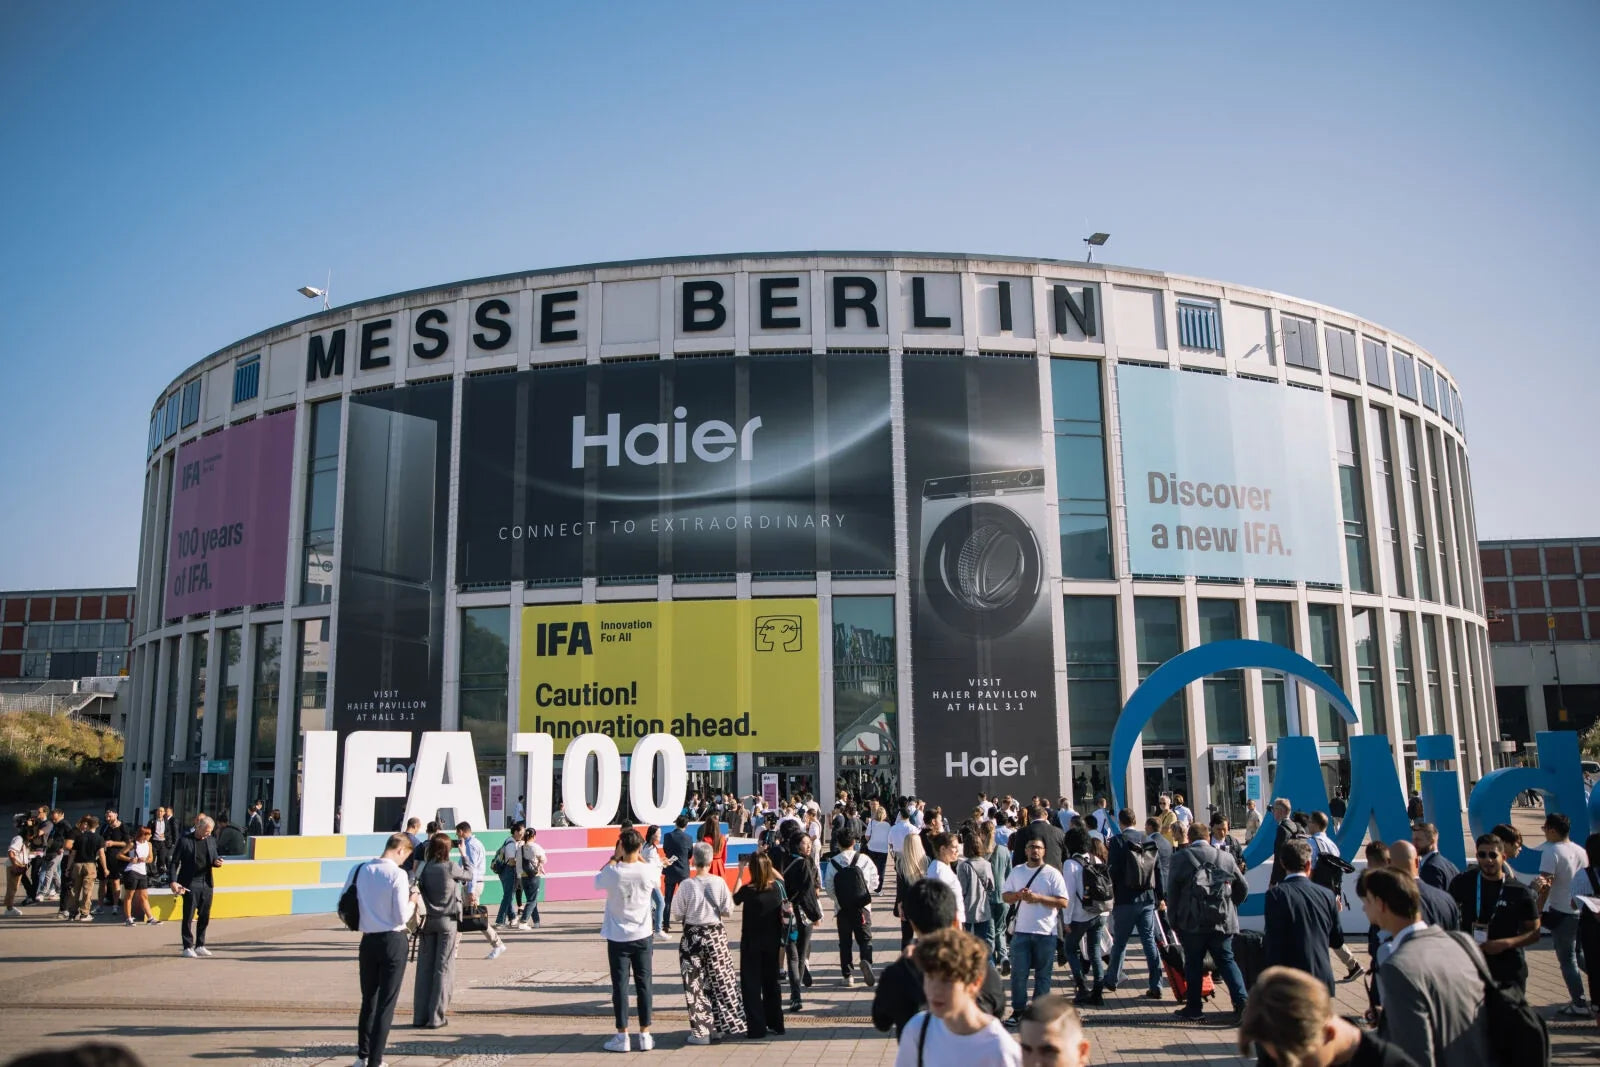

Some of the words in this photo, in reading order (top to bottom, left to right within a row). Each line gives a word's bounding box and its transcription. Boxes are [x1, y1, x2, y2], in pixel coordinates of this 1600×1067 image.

[307, 291, 578, 382] MESSE
[683, 276, 1097, 337] BERLIN
[572, 406, 762, 469] Haier
[182, 460, 200, 491] IFA
[1147, 471, 1272, 512] Discover
[178, 527, 199, 559] 100
[201, 522, 243, 559] years
[498, 521, 597, 541] CONNECT
[611, 518, 636, 535] TO
[650, 512, 847, 533] EXTRAORDINARY
[1151, 523, 1168, 550] a
[1176, 523, 1237, 553] new
[1243, 521, 1293, 556] IFA.
[174, 567, 186, 596] of
[188, 562, 212, 593] IFA.
[536, 621, 593, 657] IFA
[600, 619, 653, 631] Innovation
[600, 632, 616, 643] For
[619, 632, 633, 643] All
[373, 690, 399, 698] VISIT
[535, 681, 637, 708] Caution!
[932, 690, 970, 698] HAIER
[977, 689, 1038, 699] PAVILLON
[968, 678, 1002, 687] VISIT
[347, 702, 375, 711] HAIER
[379, 701, 427, 709] PAVILLON
[372, 713, 395, 721] HALL
[399, 712, 415, 720] 3.1
[947, 702, 961, 711] AT
[968, 702, 999, 711] HALL
[1005, 702, 1024, 711] 3.1
[535, 715, 664, 738] Innovation
[670, 711, 758, 737] ahead.
[945, 750, 1029, 778] Haier
[300, 731, 487, 836] IFA
[511, 732, 687, 829] 100
